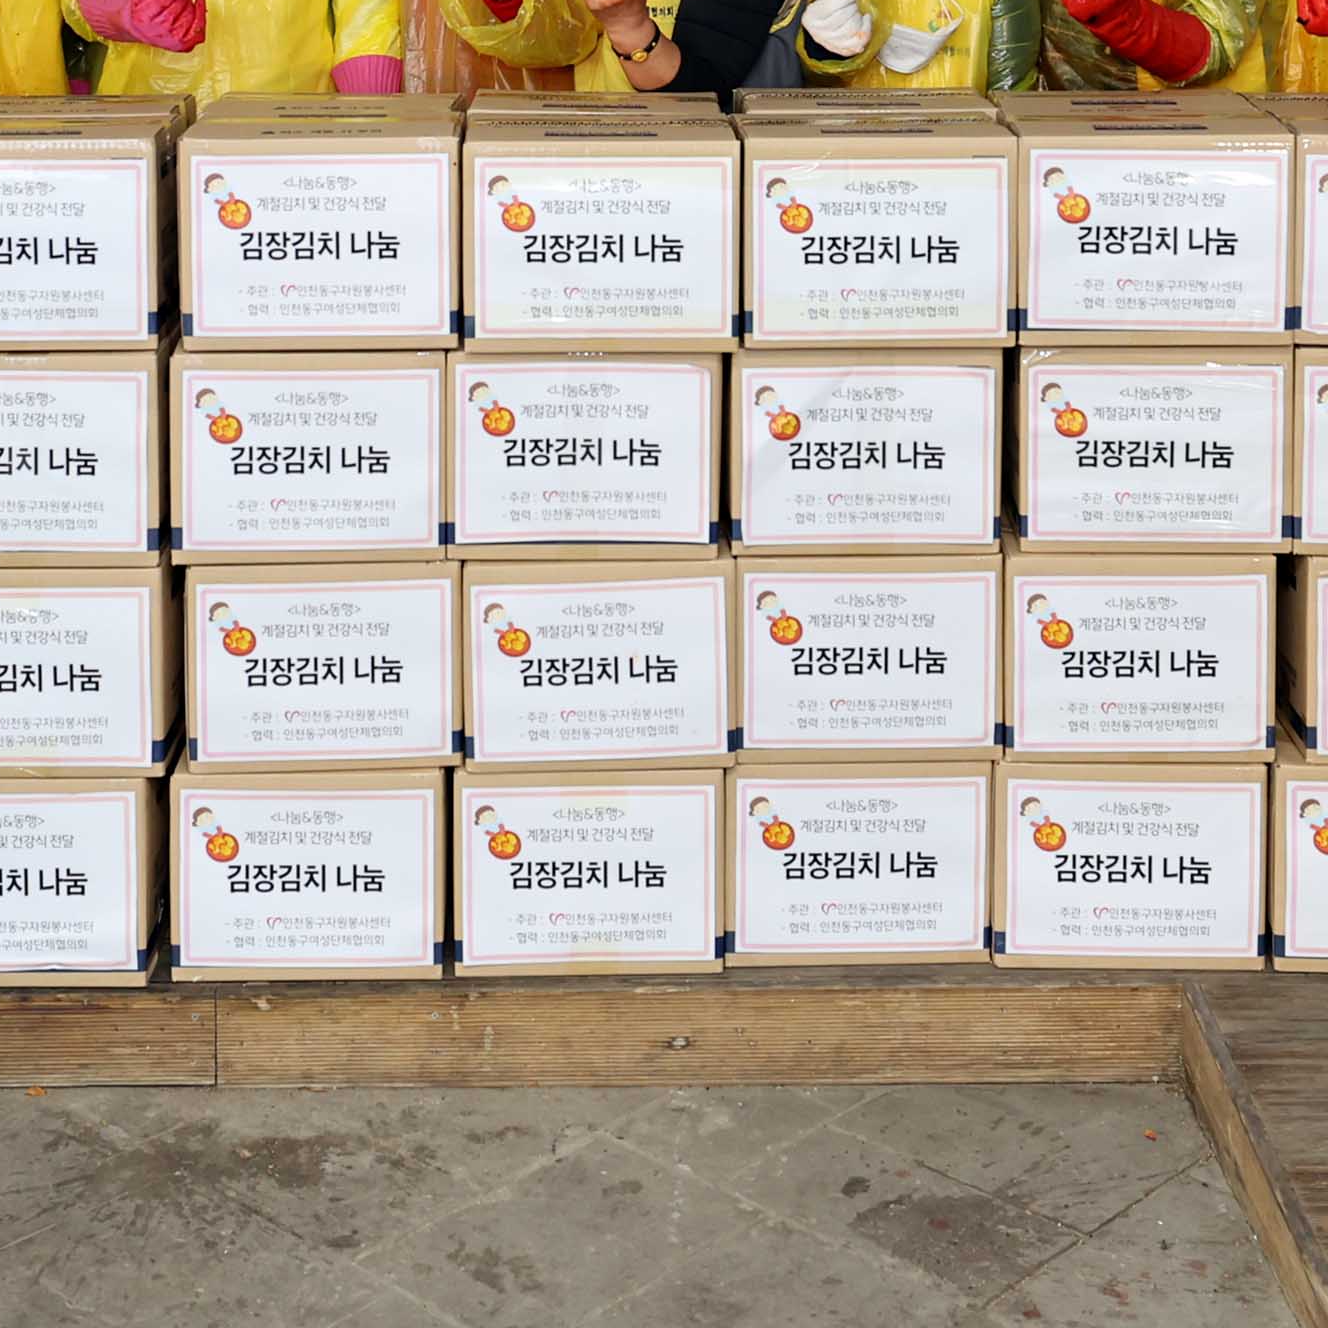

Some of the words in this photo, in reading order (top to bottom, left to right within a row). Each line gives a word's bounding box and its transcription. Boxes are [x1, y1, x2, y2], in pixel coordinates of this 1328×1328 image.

[49, 236, 98, 265] 나눔
[240, 231, 340, 261] 김장김치
[350, 231, 401, 260] 나눔
[523, 234, 624, 264] 김장김치
[634, 234, 684, 263] 나눔
[801, 235, 900, 265] 김장김치
[911, 235, 960, 264] 나눔
[1077, 225, 1178, 255] 김장김치
[1188, 227, 1238, 256] 나눔
[49, 447, 98, 476] 나눔
[231, 445, 331, 475] 김장김치
[341, 445, 390, 474] 나눔
[503, 437, 602, 467] 김장김치
[613, 438, 662, 467] 나눔
[788, 441, 886, 470] 김장김치
[897, 441, 946, 470] 나눔
[1075, 439, 1175, 468] 김장김치
[1185, 440, 1235, 469] 나눔
[245, 656, 344, 687] 김장김치
[354, 655, 404, 684] 나눔
[520, 656, 619, 687] 김장김치
[629, 655, 678, 684] 나눔
[791, 646, 889, 676] 김장김치
[899, 646, 948, 675] 나눔
[1061, 649, 1160, 679] 김장김치
[1170, 649, 1219, 678] 나눔
[53, 663, 102, 692] 나눔
[227, 864, 326, 893] 김장김치
[336, 864, 385, 893] 나눔
[510, 860, 608, 890] 김장김치
[618, 860, 667, 888] 나눔
[783, 851, 880, 880] 김장김치
[890, 851, 938, 879] 나눔
[1054, 854, 1153, 884] 김장김치
[1163, 855, 1212, 885] 나눔
[39, 867, 88, 897] 나눔
